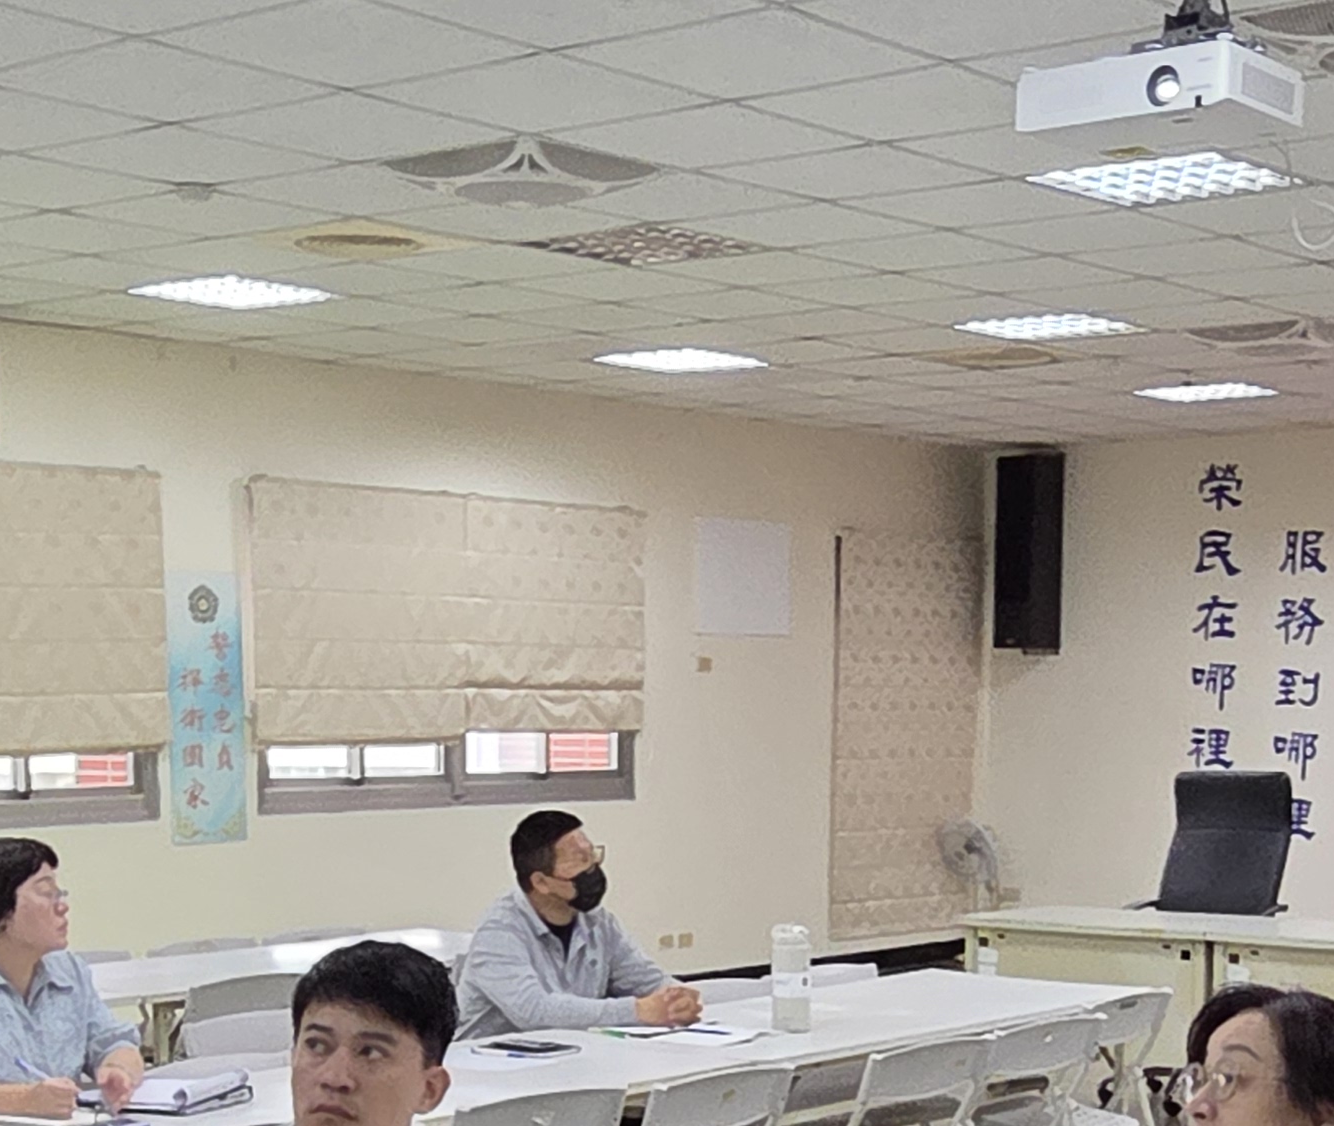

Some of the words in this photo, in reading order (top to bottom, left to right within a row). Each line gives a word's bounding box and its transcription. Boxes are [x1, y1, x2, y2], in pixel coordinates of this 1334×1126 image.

[1187, 463, 1243, 769] 榮民在哪裡
